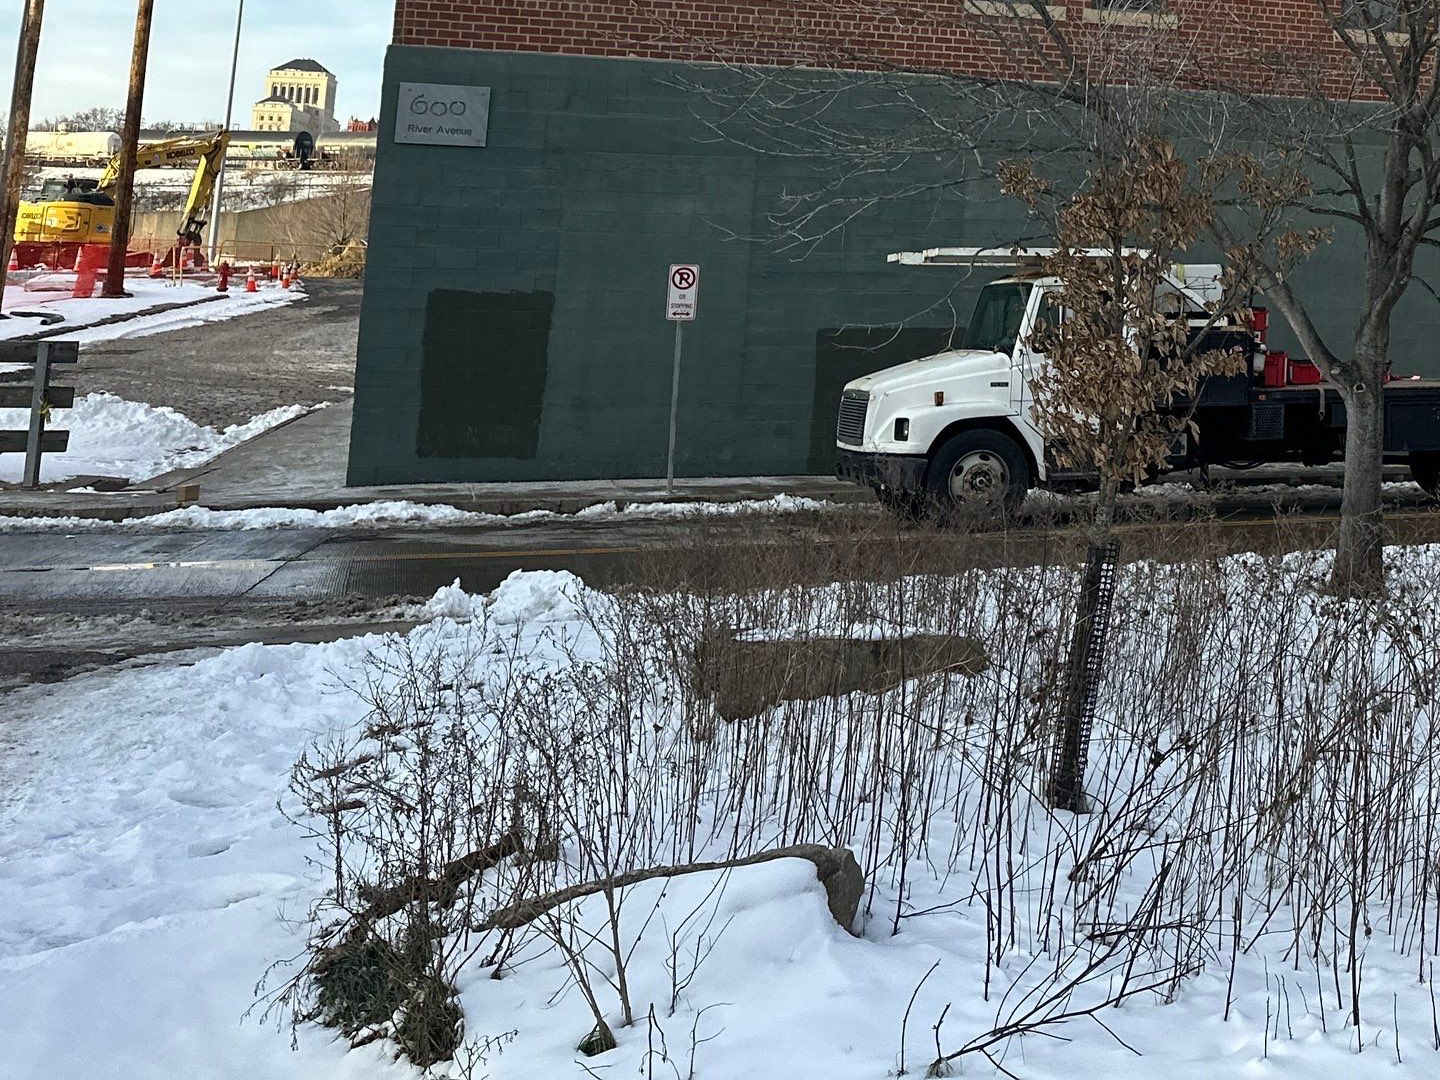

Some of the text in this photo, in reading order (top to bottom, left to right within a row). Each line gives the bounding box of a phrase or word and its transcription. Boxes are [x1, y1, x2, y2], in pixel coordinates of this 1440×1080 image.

[410, 94, 466, 116] 600
[407, 123, 472, 136] River Avenue
[166, 148, 196, 159] KOBELCO
